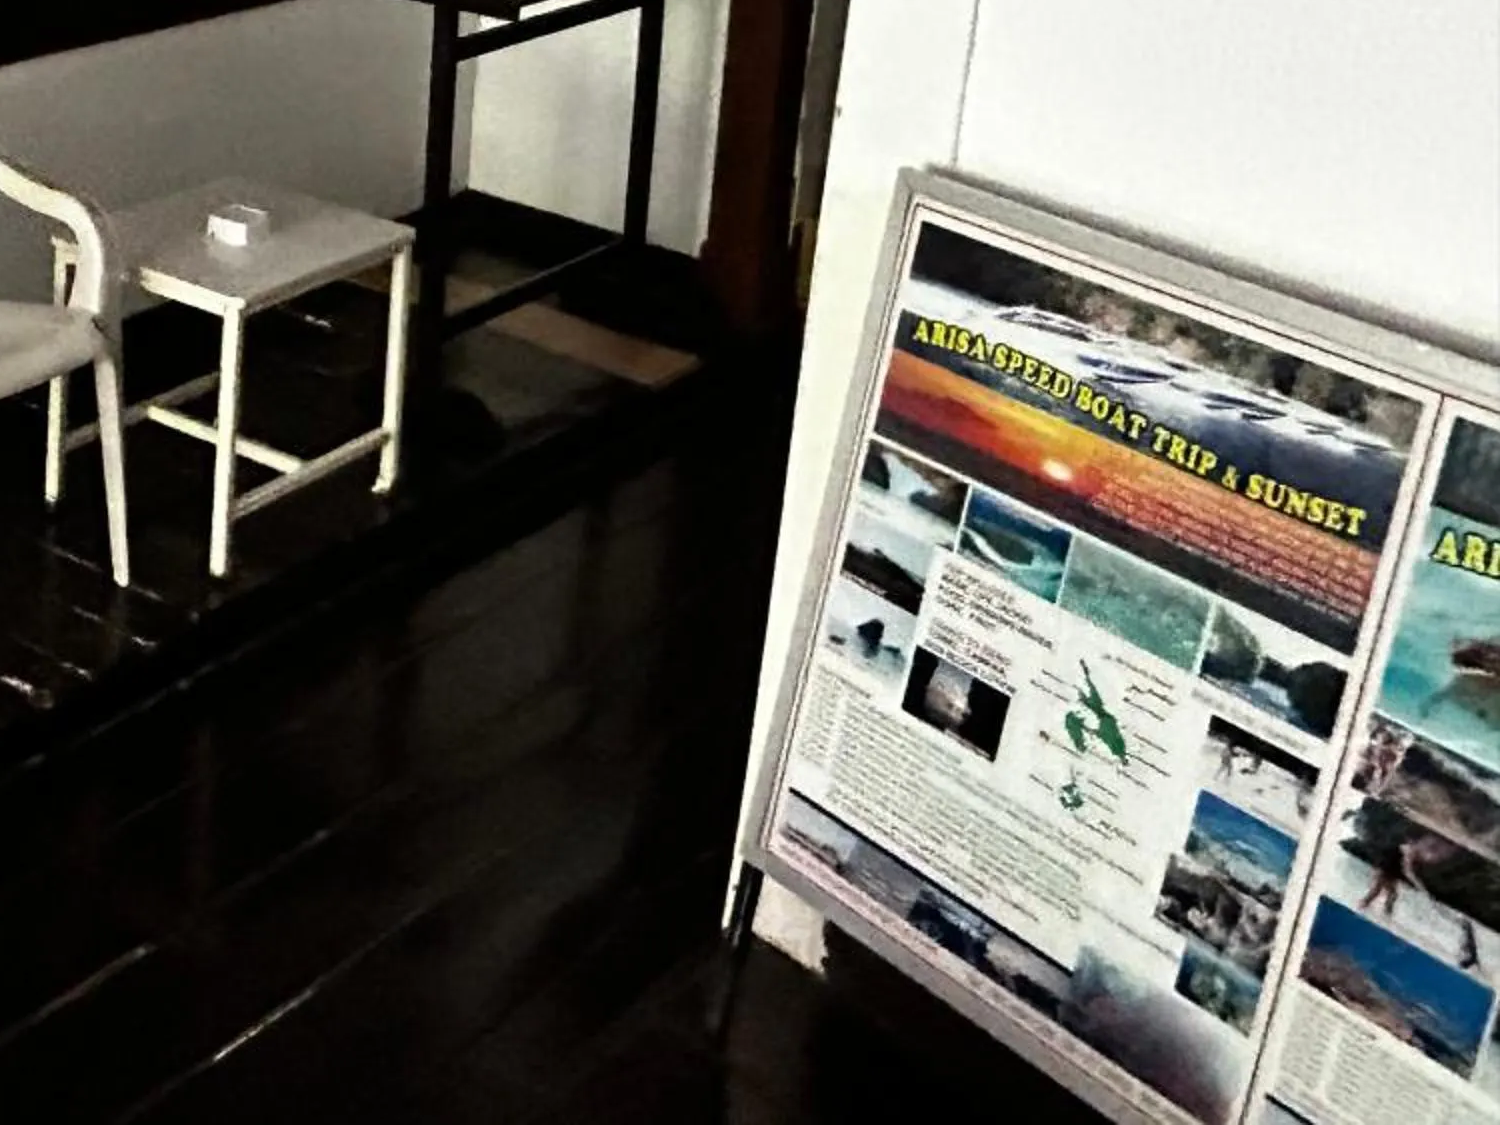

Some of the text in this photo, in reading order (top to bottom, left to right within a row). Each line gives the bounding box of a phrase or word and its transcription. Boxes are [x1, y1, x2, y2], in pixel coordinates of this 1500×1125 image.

[912, 318, 1367, 537] ARISA SPEED BOAT TRIP & SUNSET
